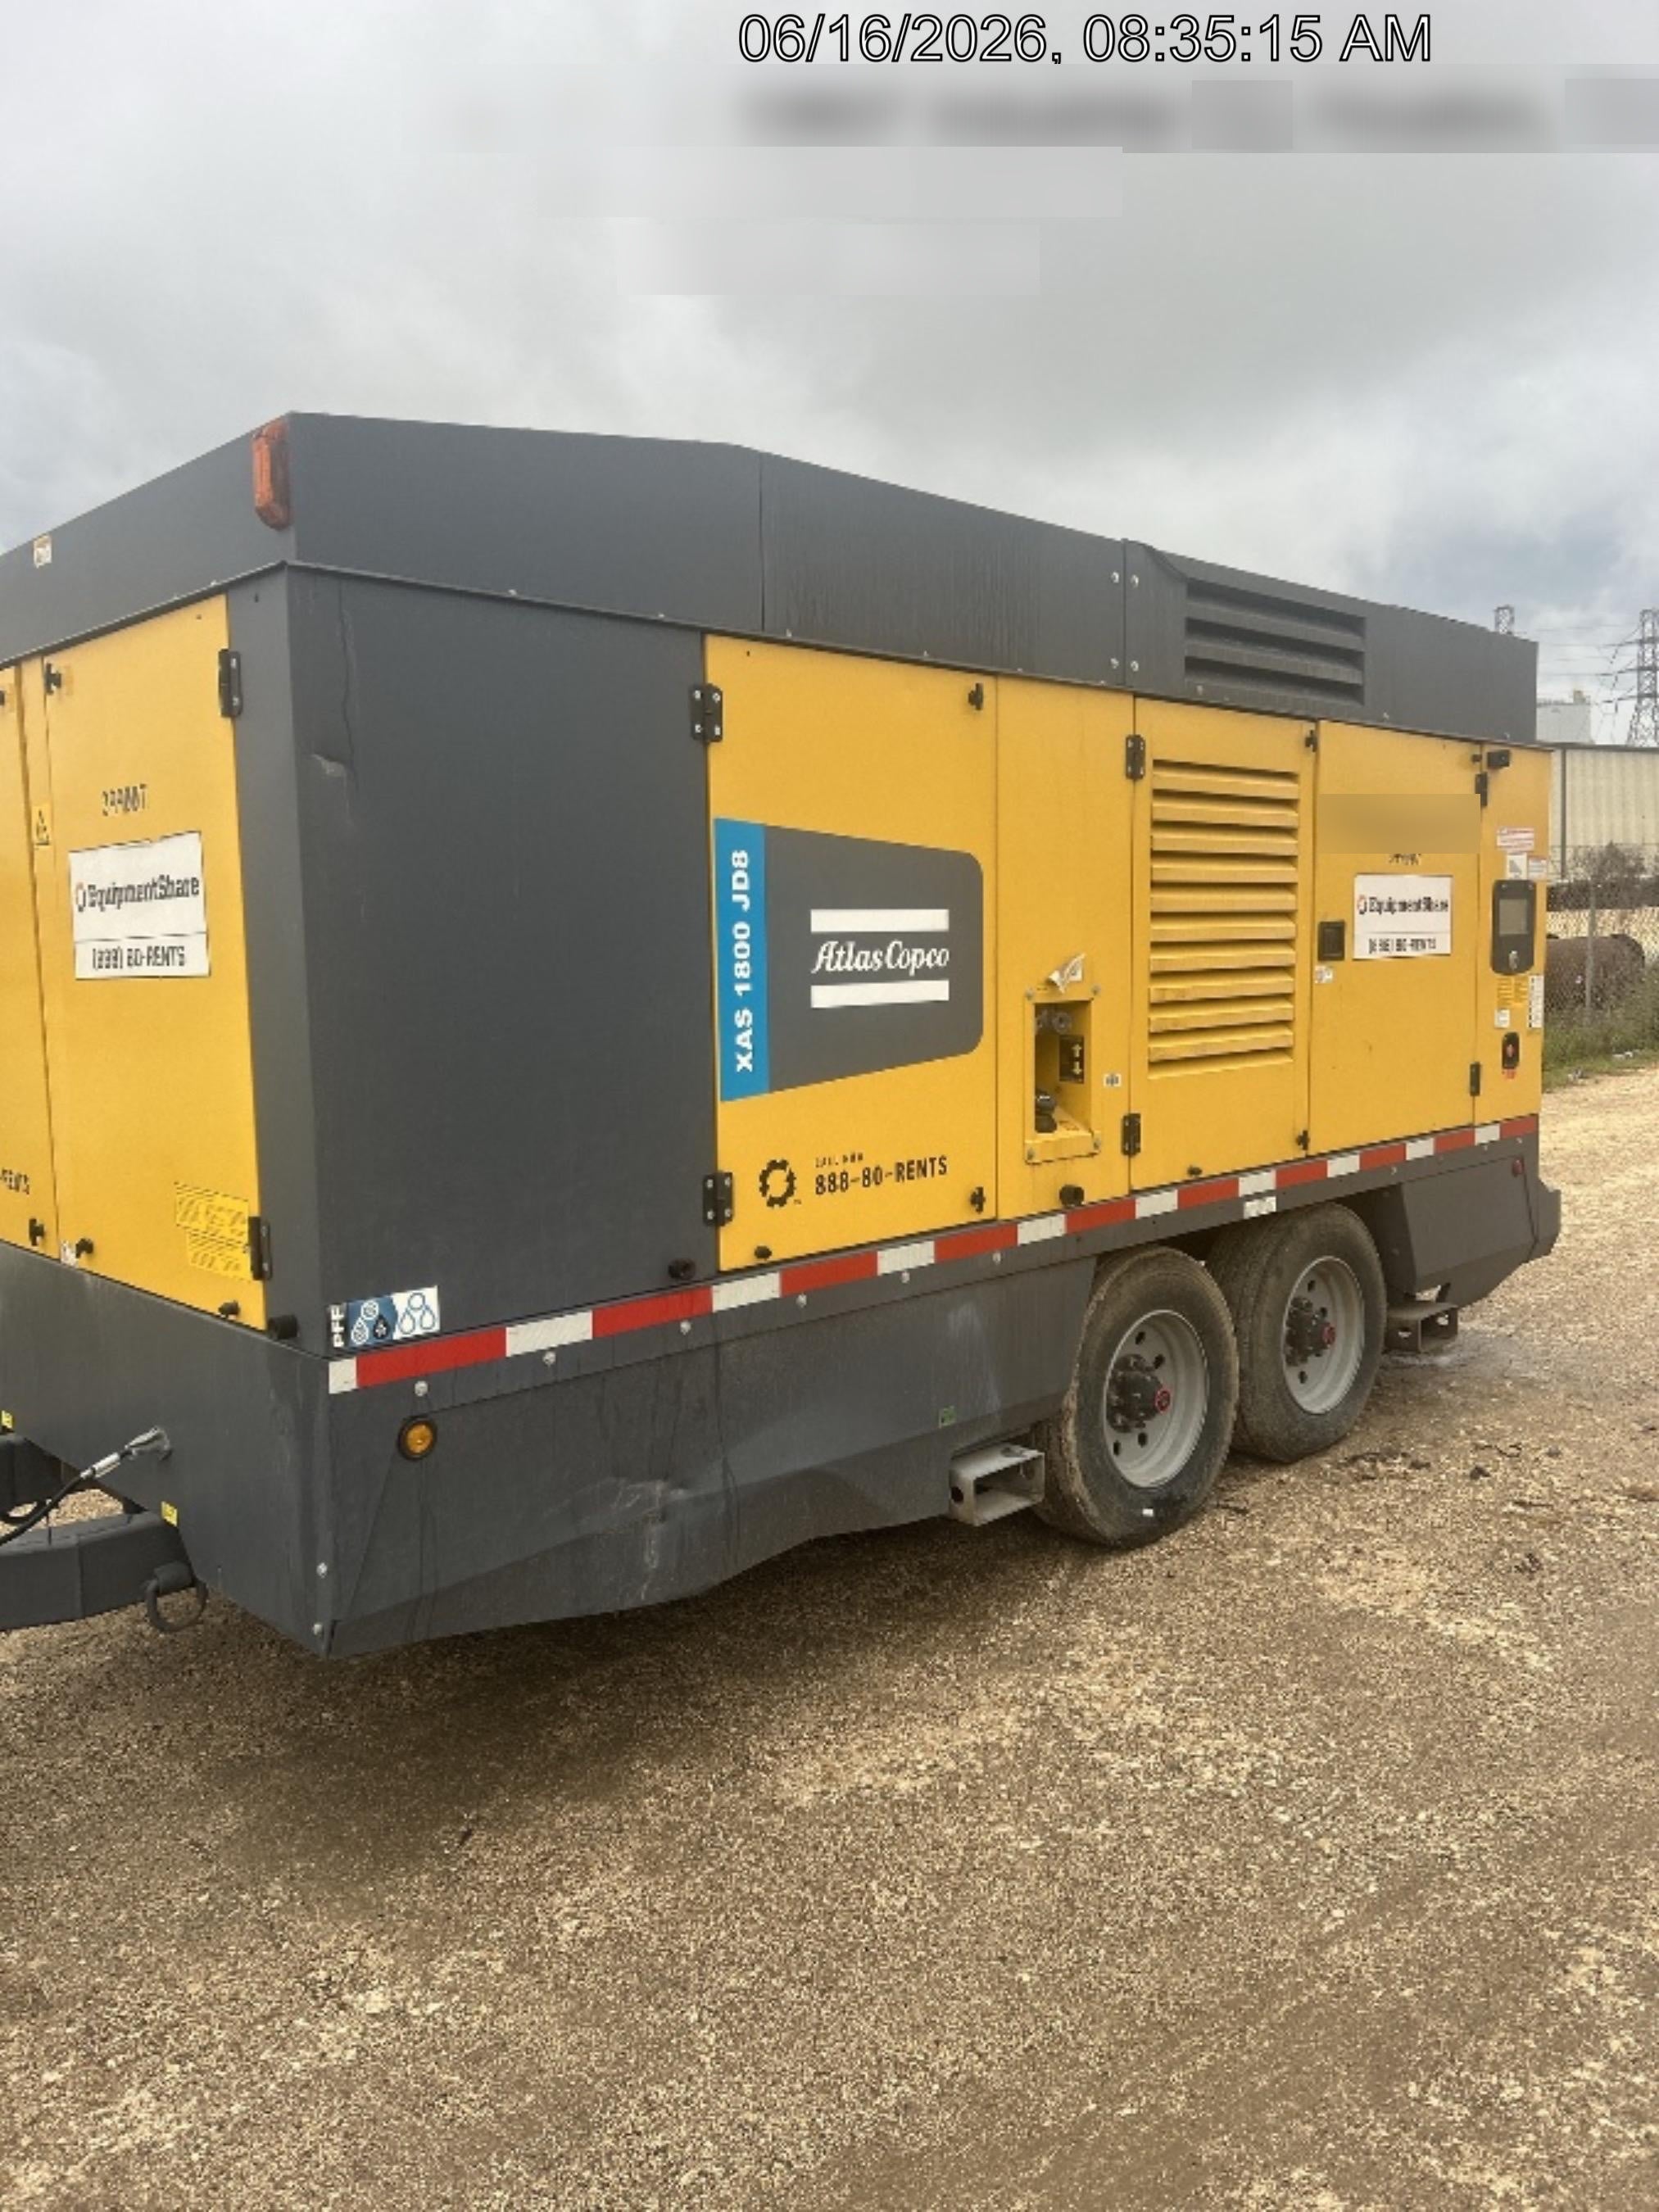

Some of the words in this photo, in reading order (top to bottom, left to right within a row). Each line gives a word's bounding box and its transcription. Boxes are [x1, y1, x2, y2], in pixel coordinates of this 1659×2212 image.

[731, 850, 750, 912] JD8
[732, 921, 751, 997] 1800
[810, 940, 883, 974] Atlas
[884, 939, 950, 977] Copco
[734, 1009, 753, 1072] XAS
[815, 1154, 948, 1195] 888-80-RENTS
